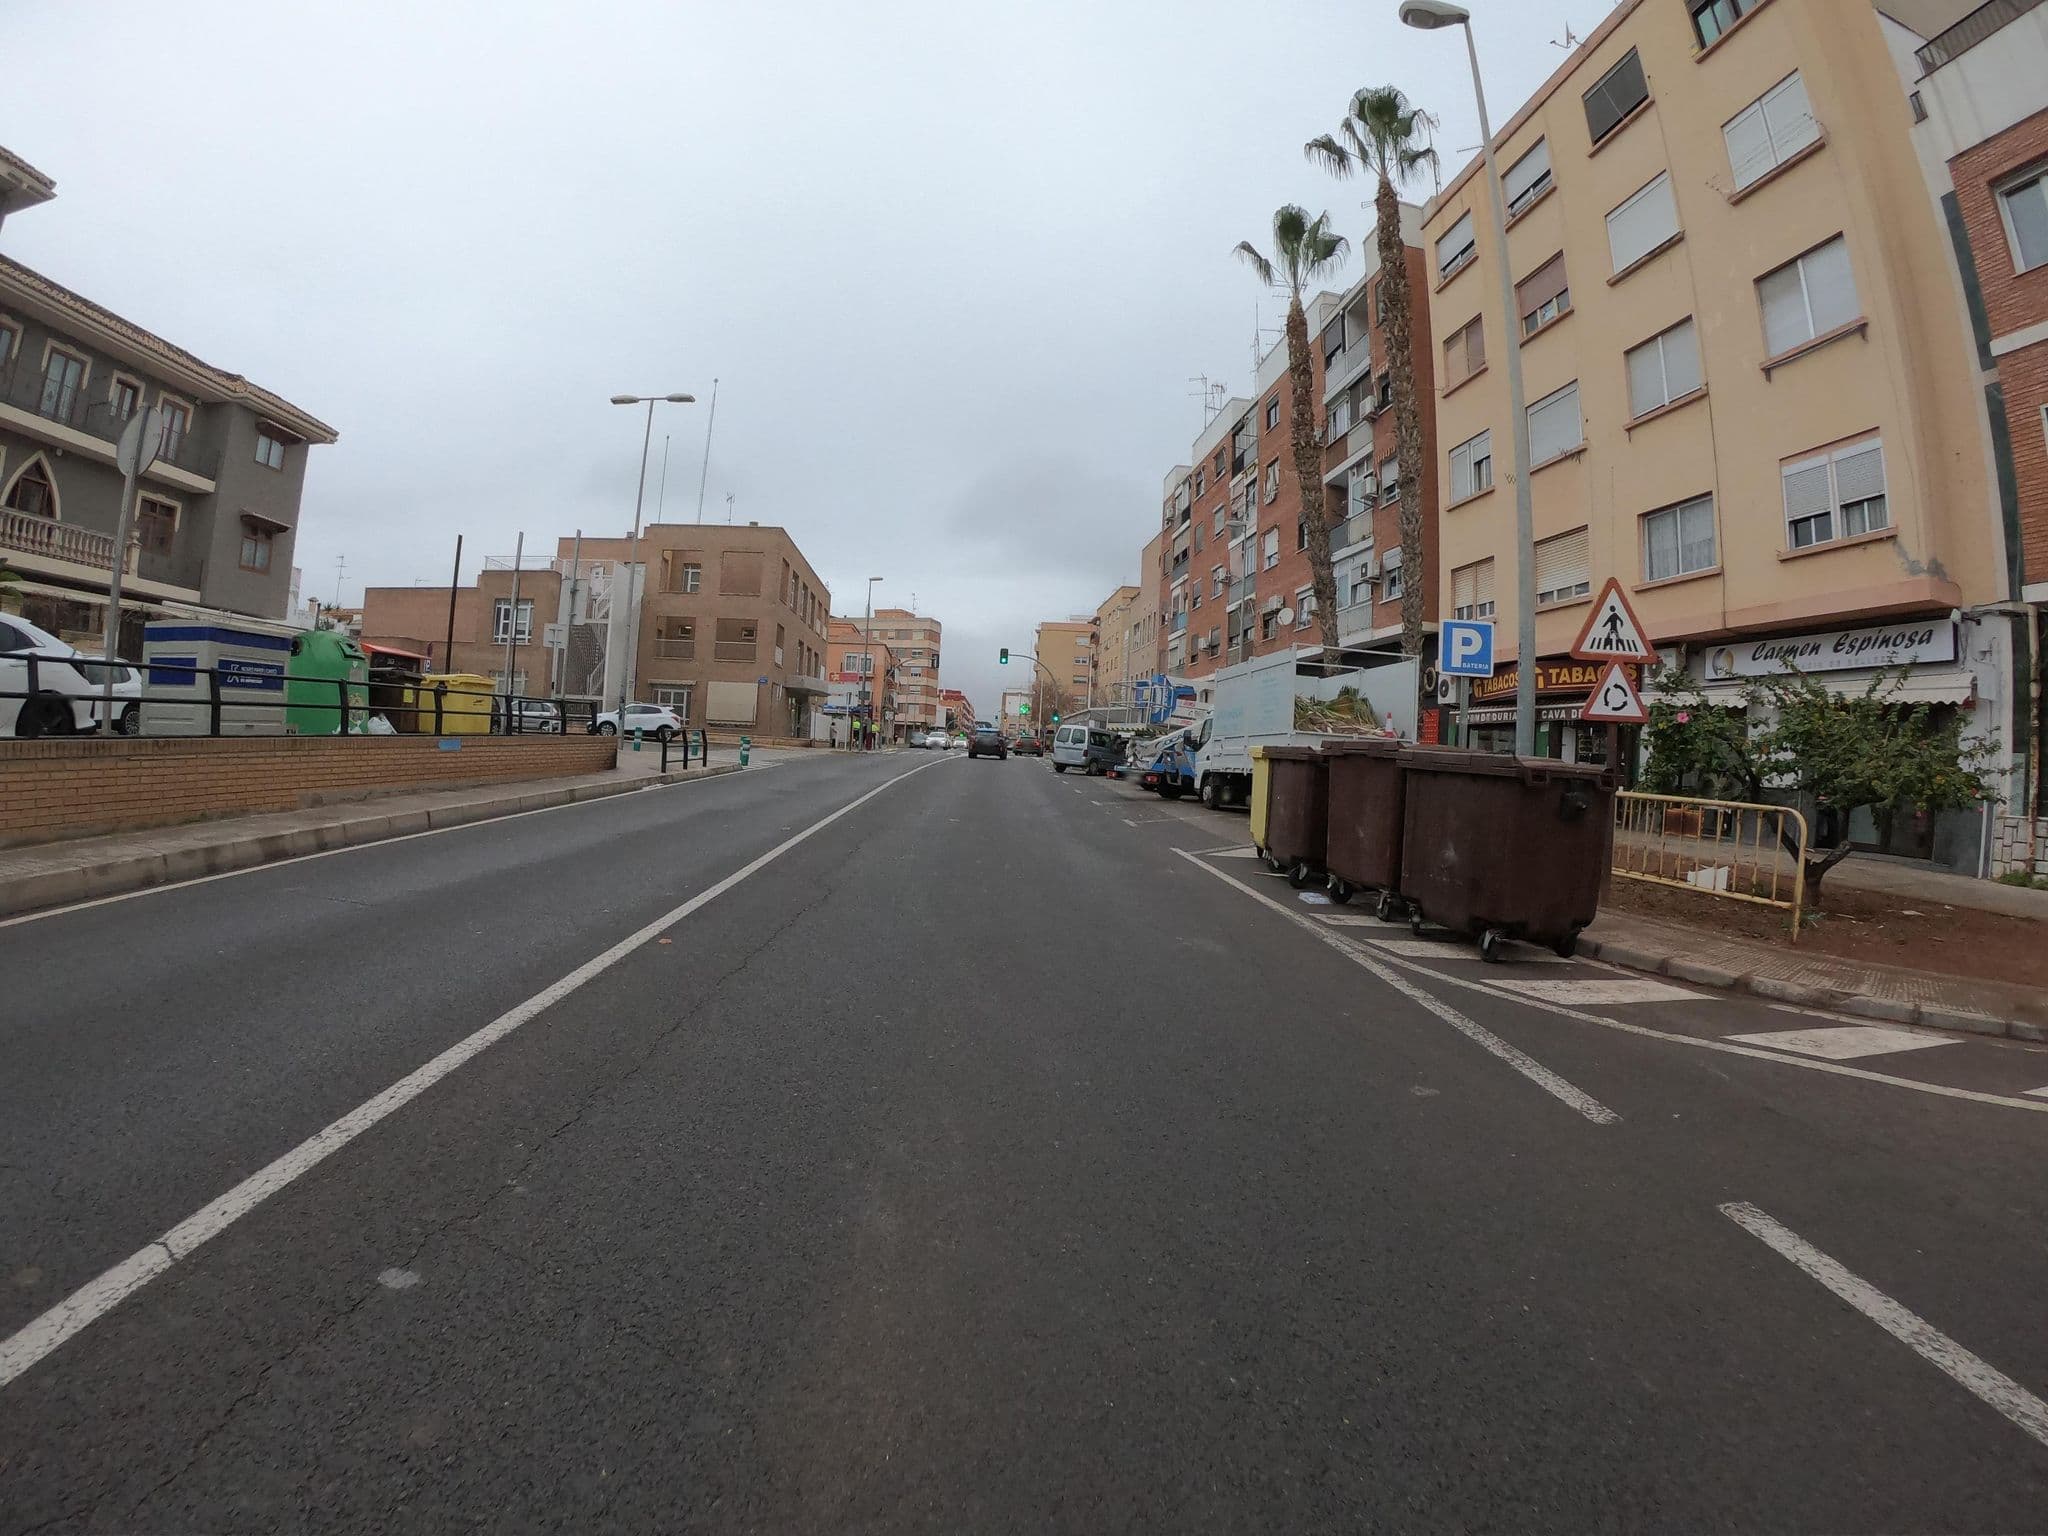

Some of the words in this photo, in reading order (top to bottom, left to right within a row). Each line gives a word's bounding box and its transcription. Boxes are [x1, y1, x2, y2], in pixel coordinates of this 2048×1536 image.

[1451, 627, 1482, 668] P
[1751, 642, 1821, 661] Carmen
[1833, 629, 1933, 656] Espinosa
[1462, 662, 1489, 670] BATERIA
[1548, 664, 1637, 685] TABACS
[1541, 709, 1566, 719] CAVA
